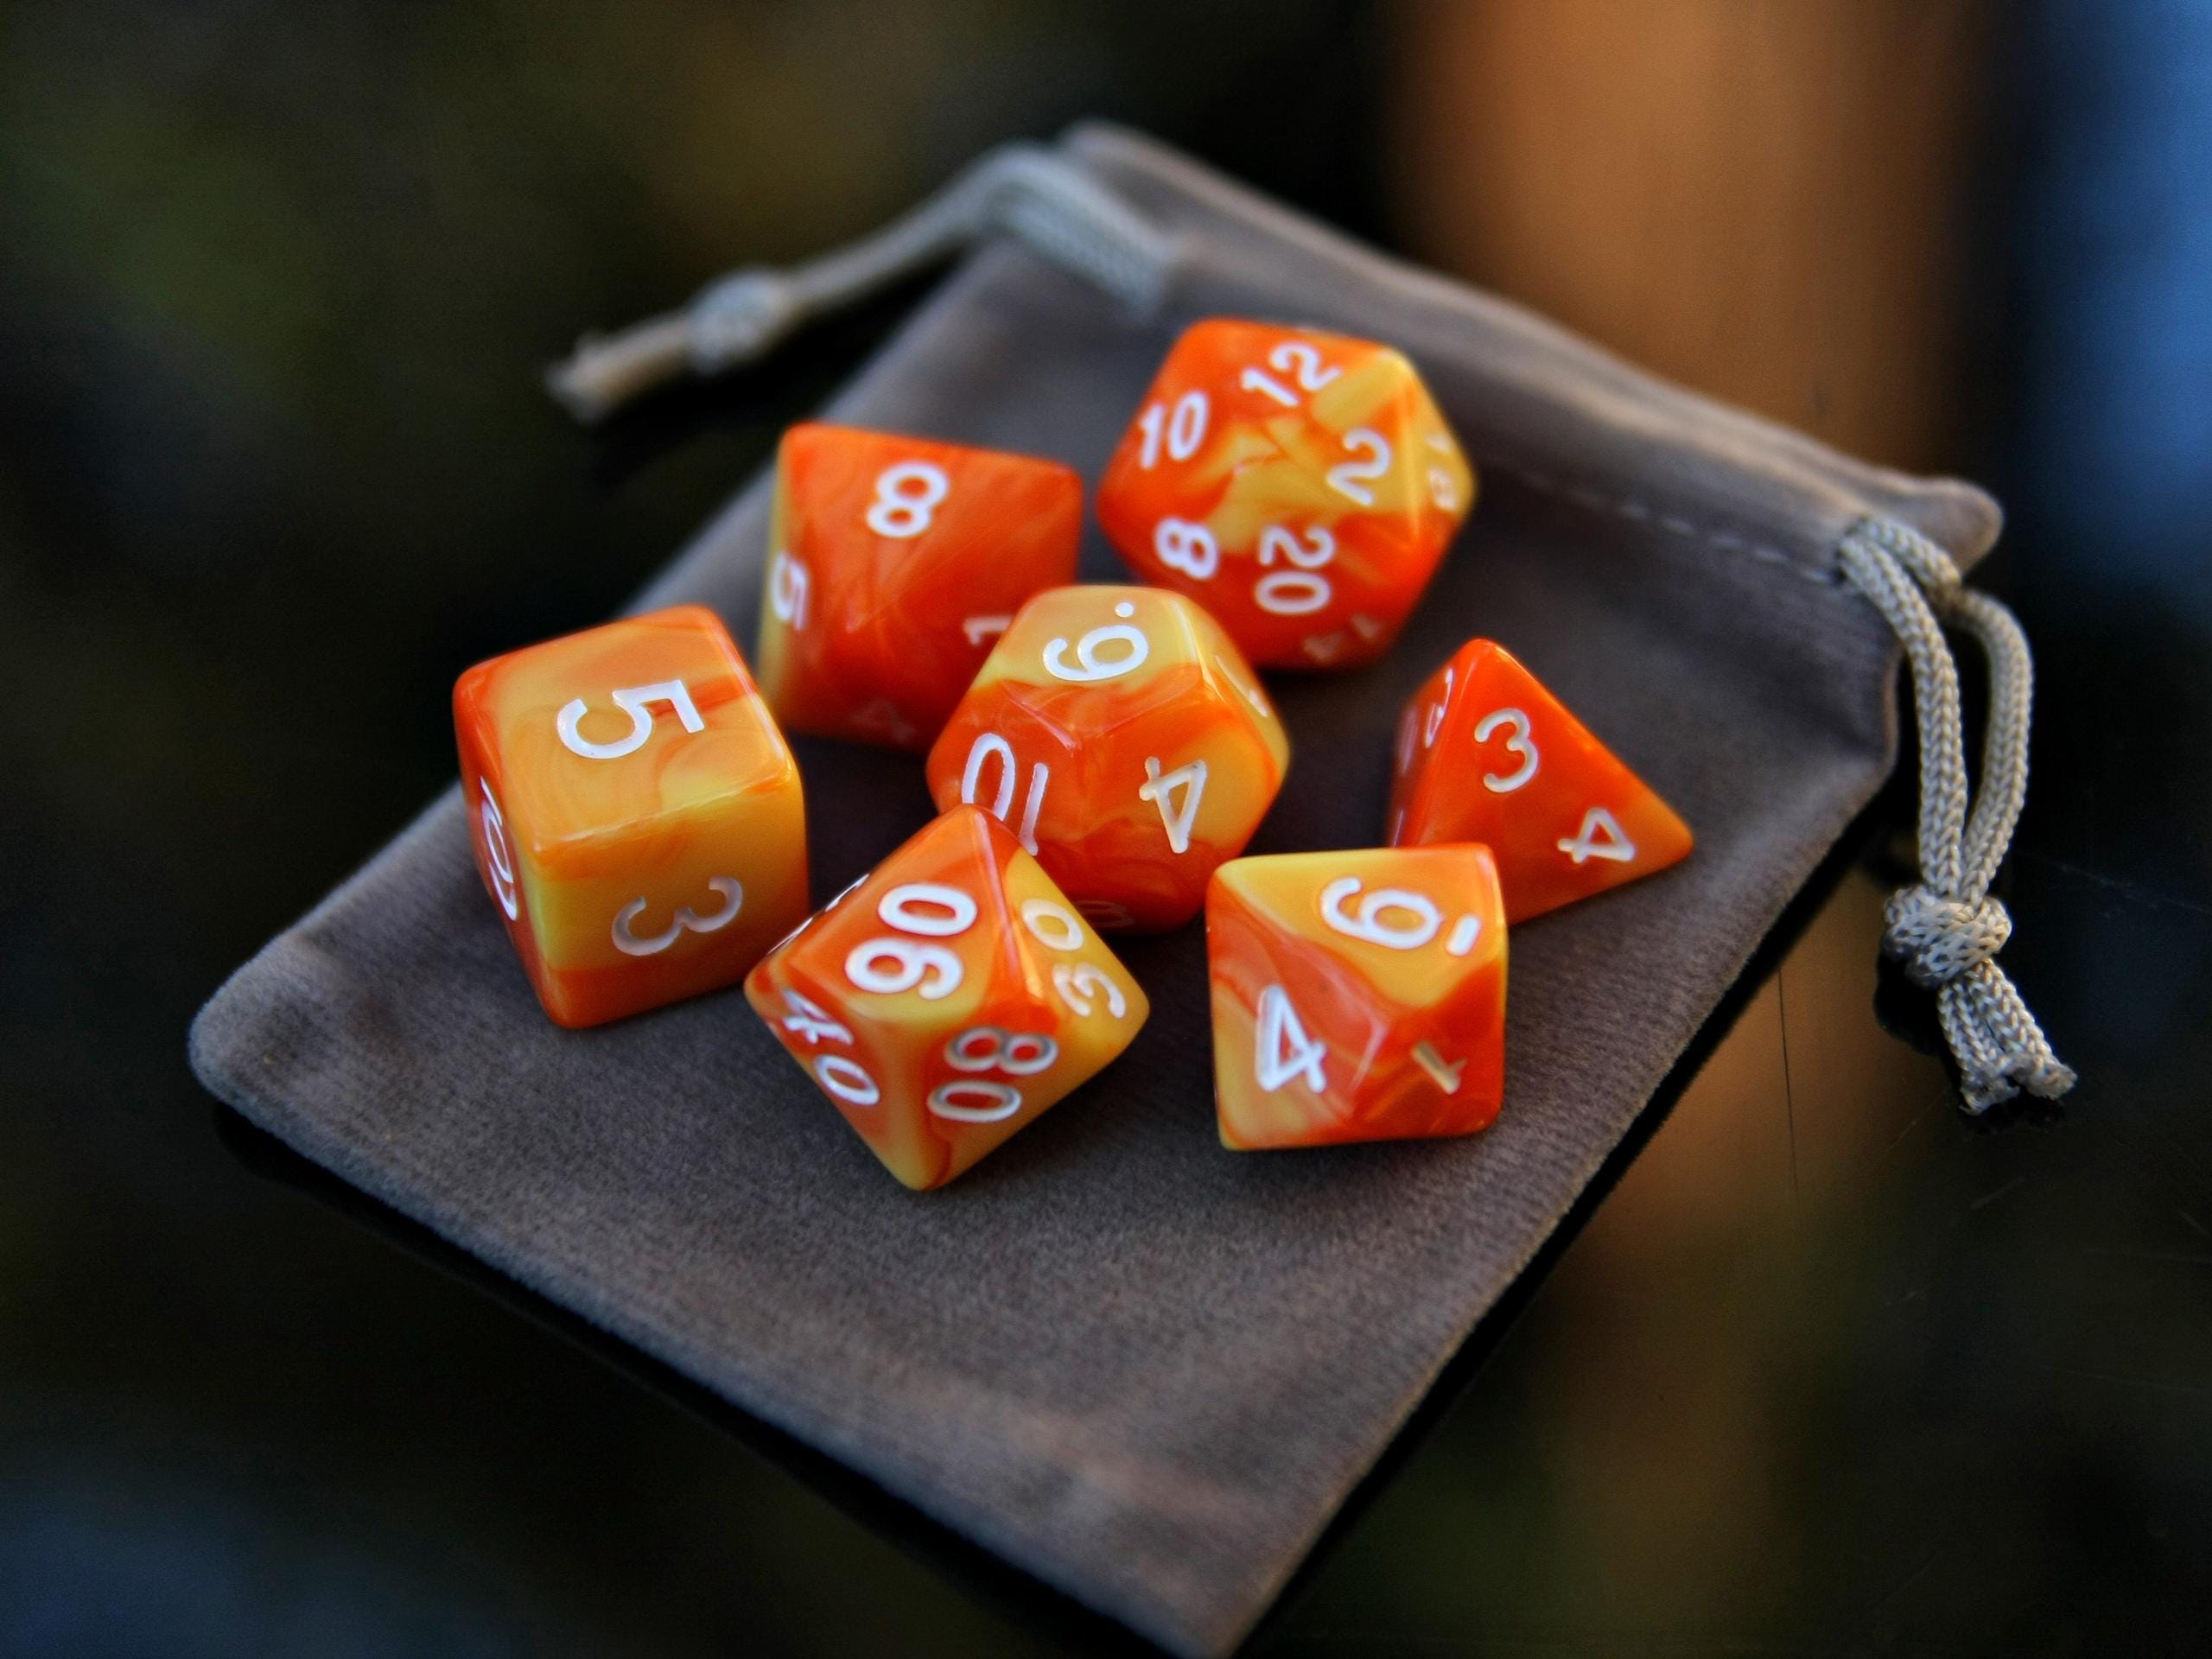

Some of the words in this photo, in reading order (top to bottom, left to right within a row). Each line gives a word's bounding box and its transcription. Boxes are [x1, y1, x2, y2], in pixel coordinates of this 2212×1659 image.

[1240, 341, 1344, 408] 12
[1140, 390, 1207, 470] 10
[1325, 428, 1392, 507] 2
[866, 461, 950, 538] 8
[1154, 516, 1219, 581] 8
[1253, 524, 1336, 616] 20
[556, 678, 705, 760] 5
[1474, 708, 1538, 793] 3
[962, 732, 1049, 856] 10
[1139, 755, 1208, 855] 4
[1557, 807, 1636, 864] 4
[611, 875, 744, 956] 3
[844, 882, 978, 1001] 90
[1020, 898, 1127, 1020] 30
[782, 986, 880, 1106] 40
[926, 1027, 1058, 1123] 80
[1255, 983, 1328, 1094] 4
[1409, 1041, 1468, 1096] 1
